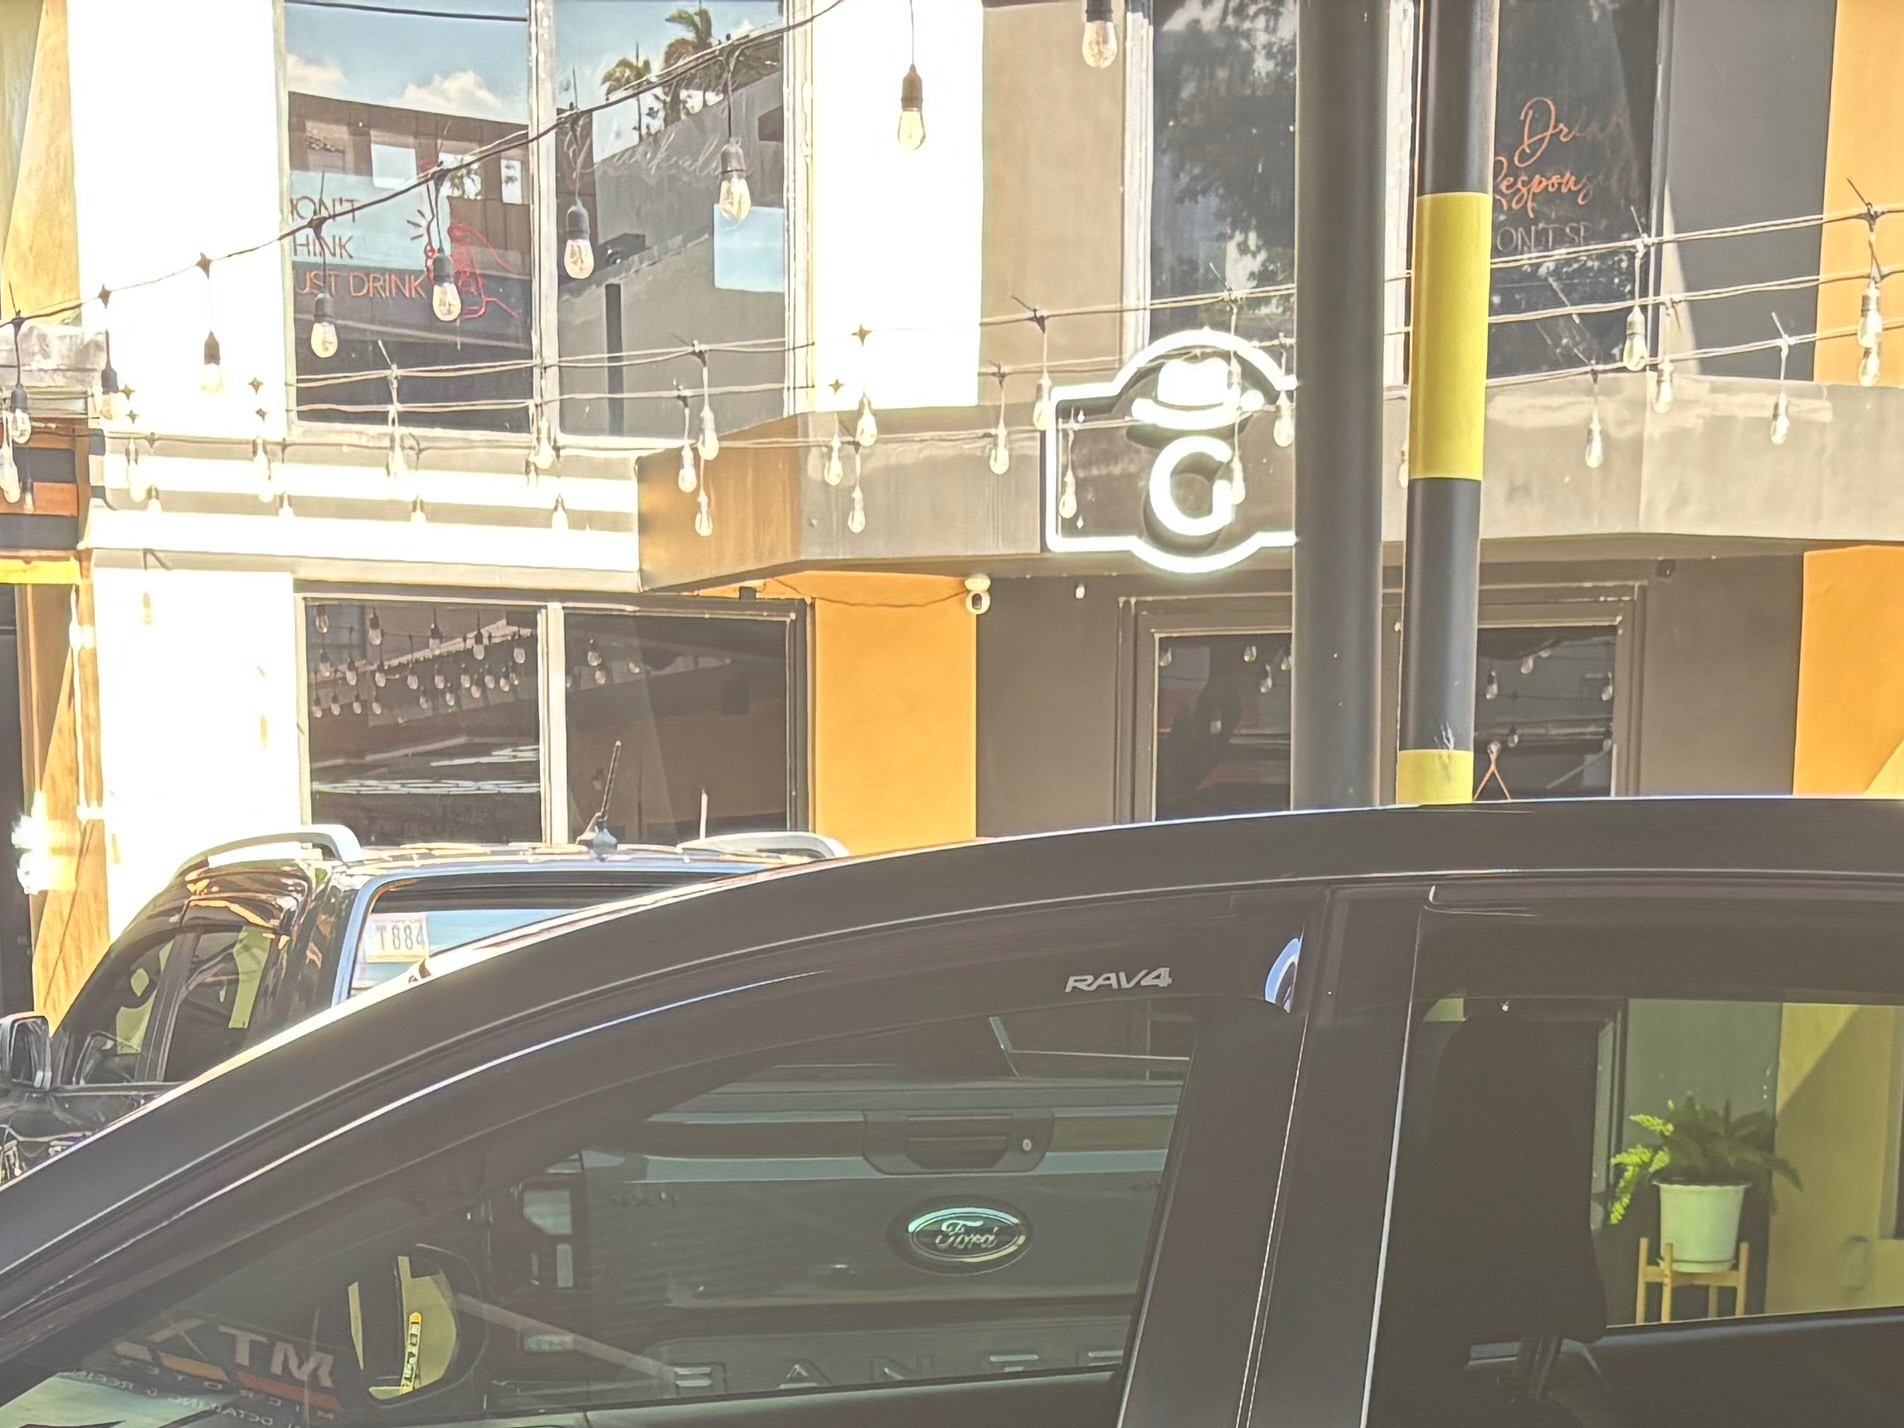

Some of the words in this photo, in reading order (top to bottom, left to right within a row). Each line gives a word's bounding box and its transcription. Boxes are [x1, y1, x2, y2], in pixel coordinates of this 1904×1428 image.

[292, 234, 355, 260] HINK
[349, 270, 428, 300] DRINK
[1064, 966, 1173, 993] RAV4
[935, 1219, 999, 1249] Ford
